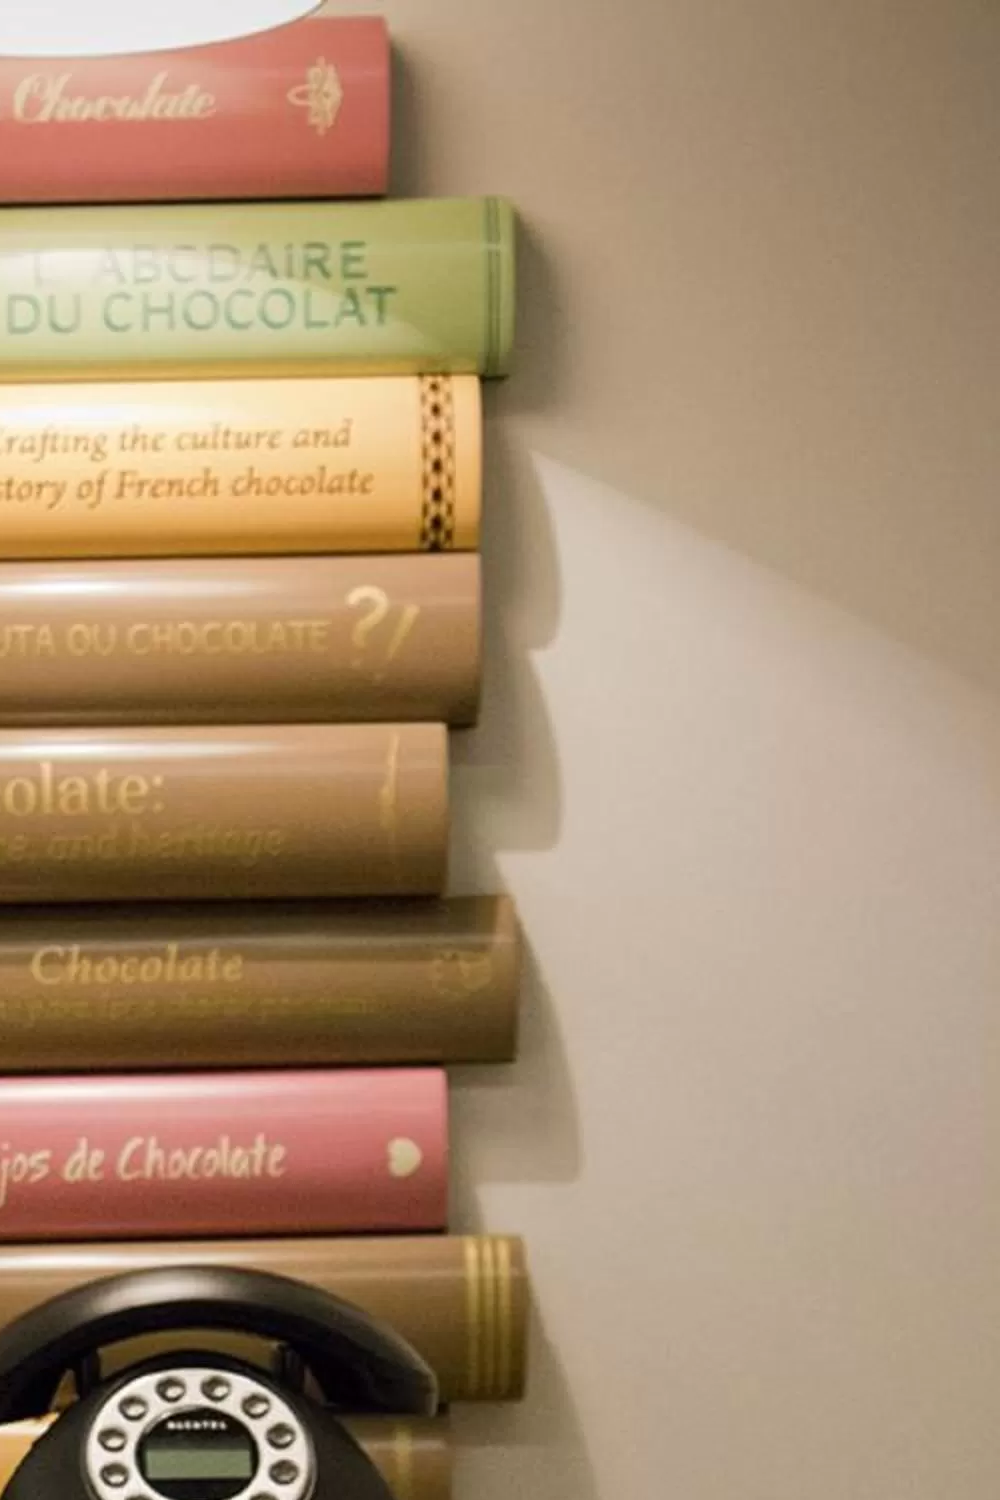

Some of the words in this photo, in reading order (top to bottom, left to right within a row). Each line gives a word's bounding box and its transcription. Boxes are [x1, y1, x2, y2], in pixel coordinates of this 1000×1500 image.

[12, 70, 218, 124] Chocolate
[6, 292, 82, 335] DU
[102, 285, 398, 333] CHOCOLAT
[120, 422, 165, 453] the
[175, 422, 280, 452] culture
[291, 419, 354, 449] and
[76, 470, 112, 507] of
[114, 467, 220, 499] French
[231, 465, 375, 497] chocolate
[66, 622, 116, 656] OU
[127, 619, 332, 655] CHOCOLATE
[30, 943, 245, 986] Chocolate
[63, 1137, 105, 1183] de
[117, 1132, 288, 1182] Chocolate
